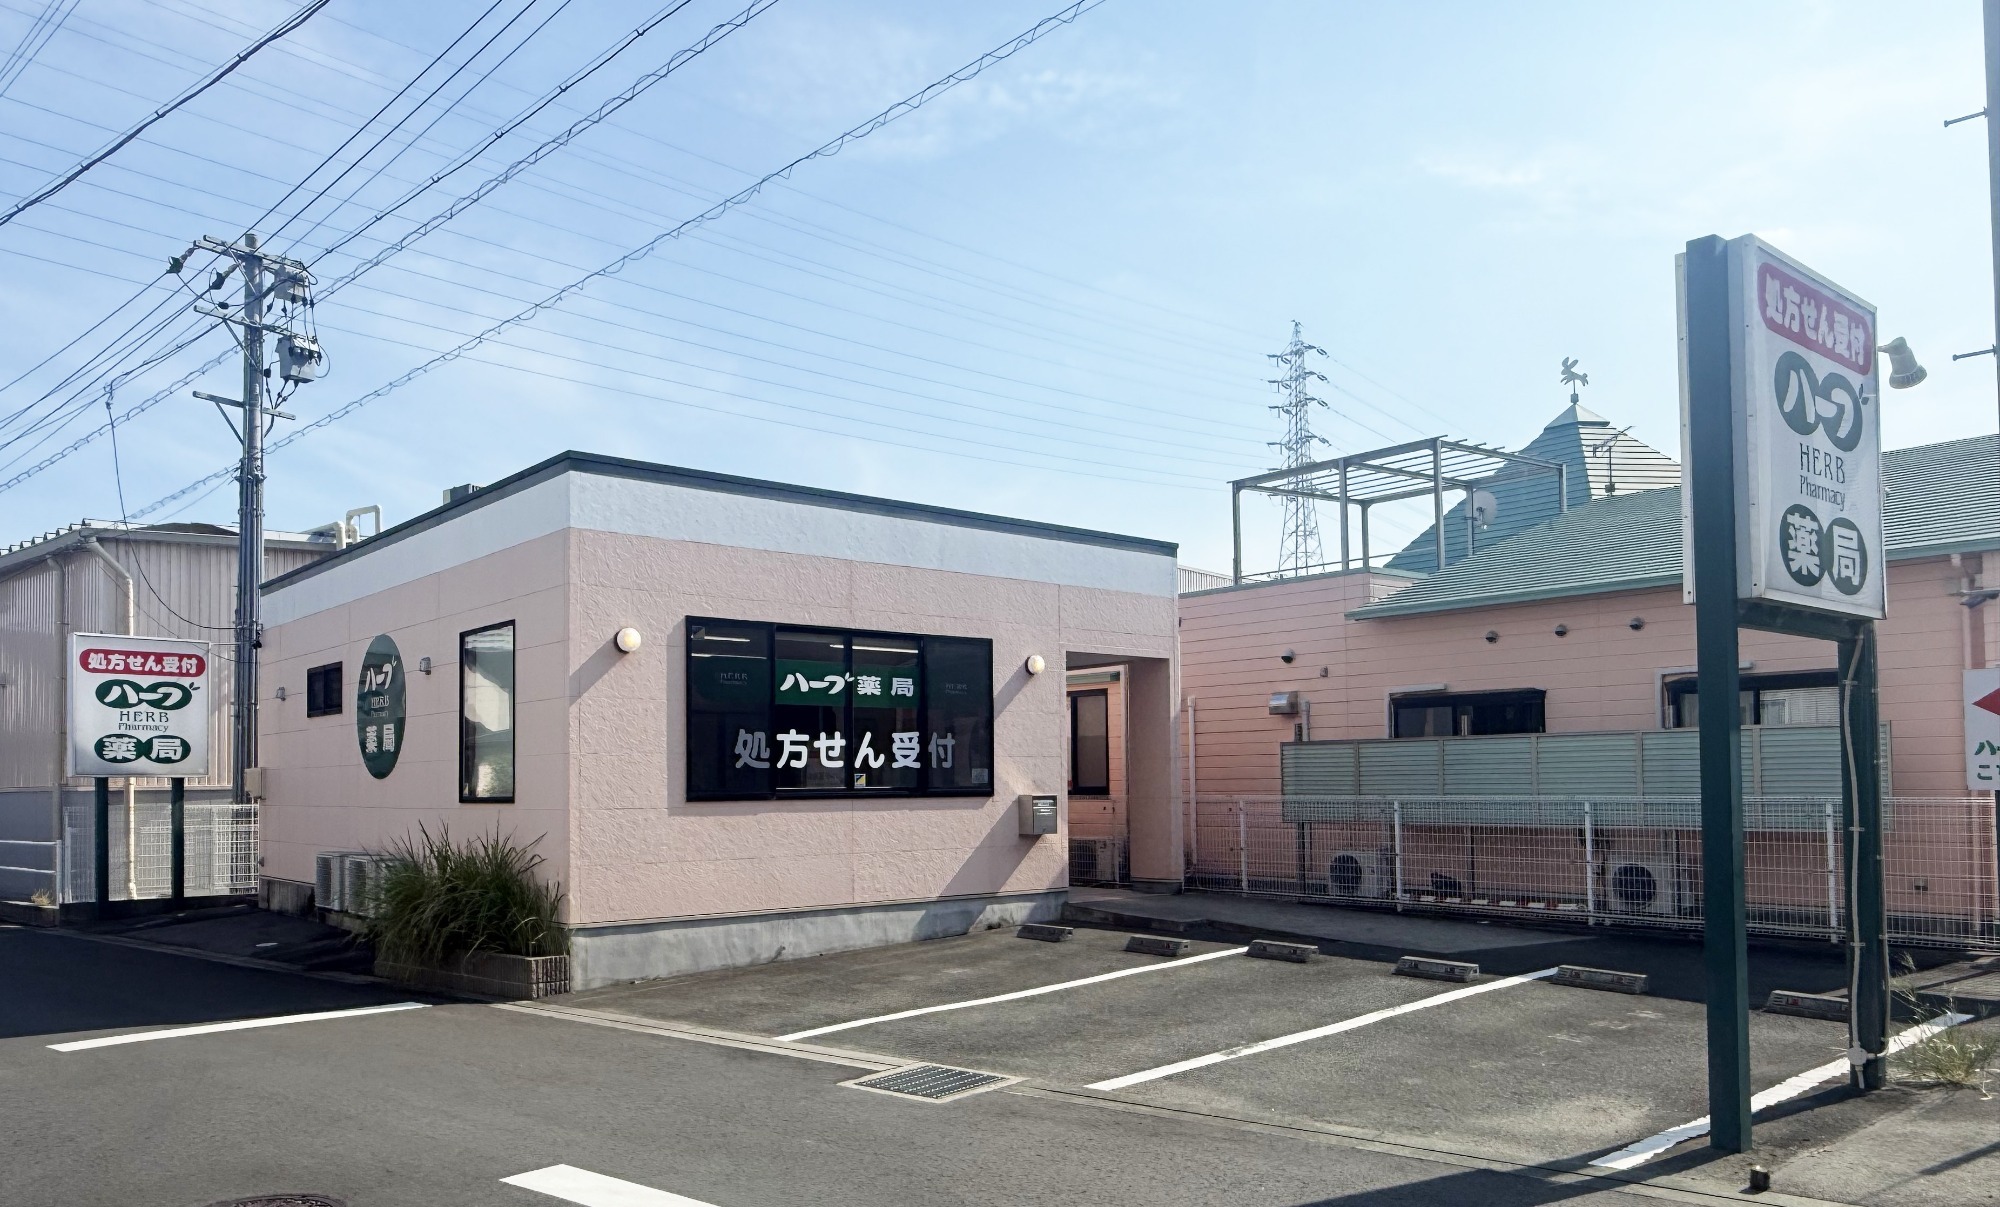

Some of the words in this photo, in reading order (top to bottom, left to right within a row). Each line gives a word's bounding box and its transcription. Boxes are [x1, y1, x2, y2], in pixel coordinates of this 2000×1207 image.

[1765, 273, 1864, 366] 処方せん受付
[1783, 369, 1869, 439] ハーブ
[1800, 443, 1845, 484] HERB
[1800, 474, 1845, 511] Pharmacy
[1786, 512, 1860, 586] 薬局
[88, 652, 198, 674] 処方せん受付
[103, 681, 201, 707] ハーブ
[118, 722, 169, 733] Pharmacy
[119, 710, 169, 723] HERB
[102, 737, 183, 760] 薬局
[734, 728, 956, 769] 処方せん受付
[1974, 739, 2000, 756] ハ
[1977, 764, 2000, 781] こ
